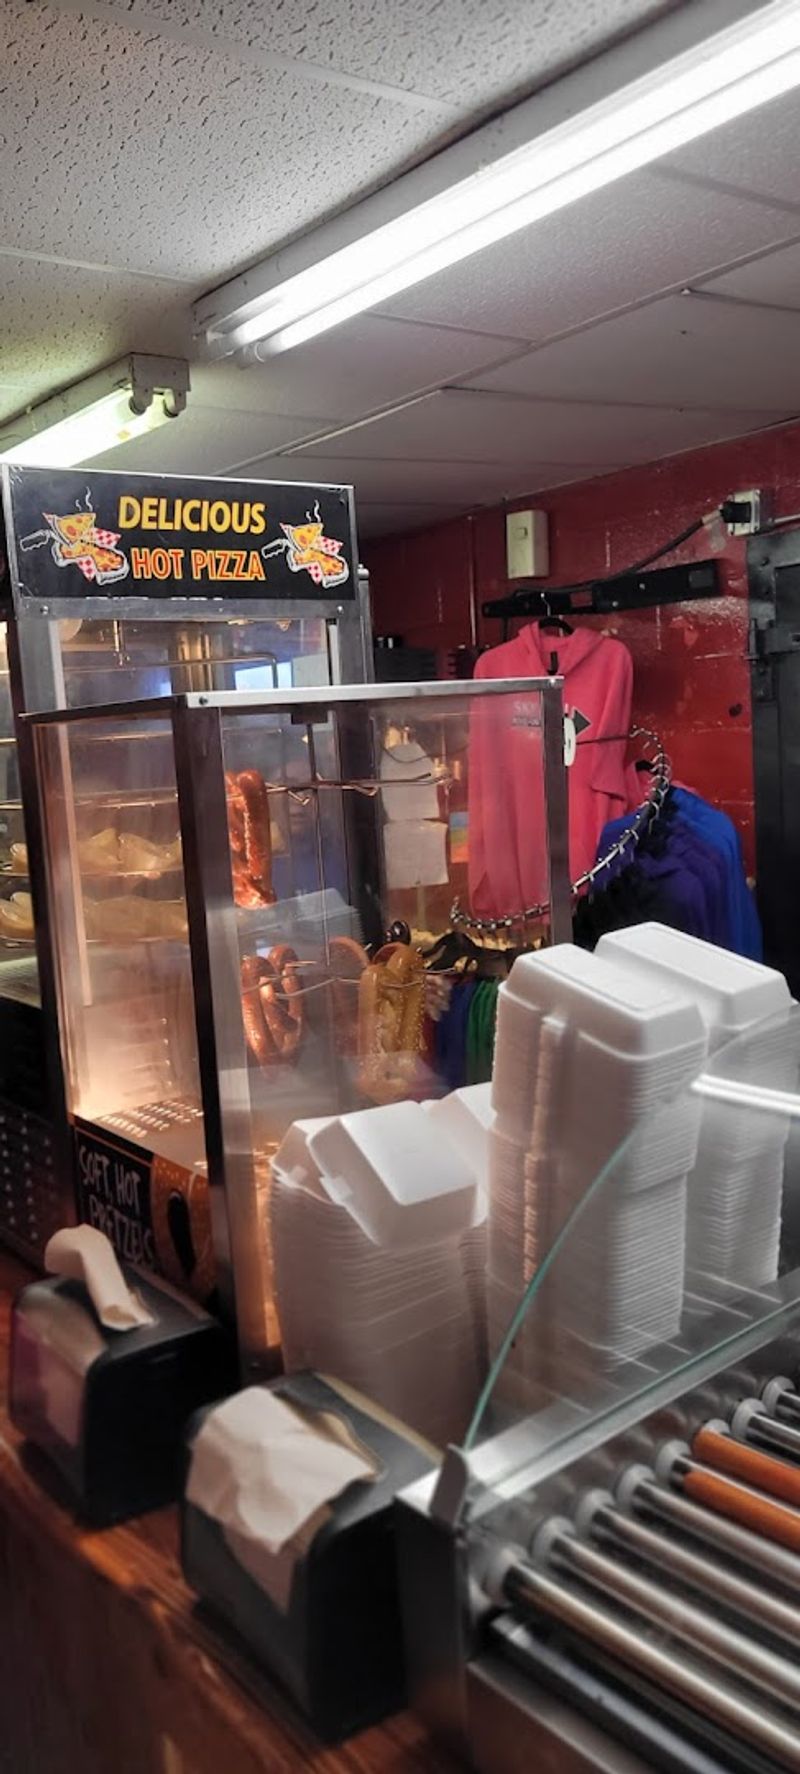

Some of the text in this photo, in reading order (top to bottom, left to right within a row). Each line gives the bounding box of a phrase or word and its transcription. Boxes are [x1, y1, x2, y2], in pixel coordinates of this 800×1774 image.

[118, 496, 267, 534] DELICIOUS
[131, 548, 266, 581] HOT PIZZA
[115, 1162, 142, 1216] HOT
